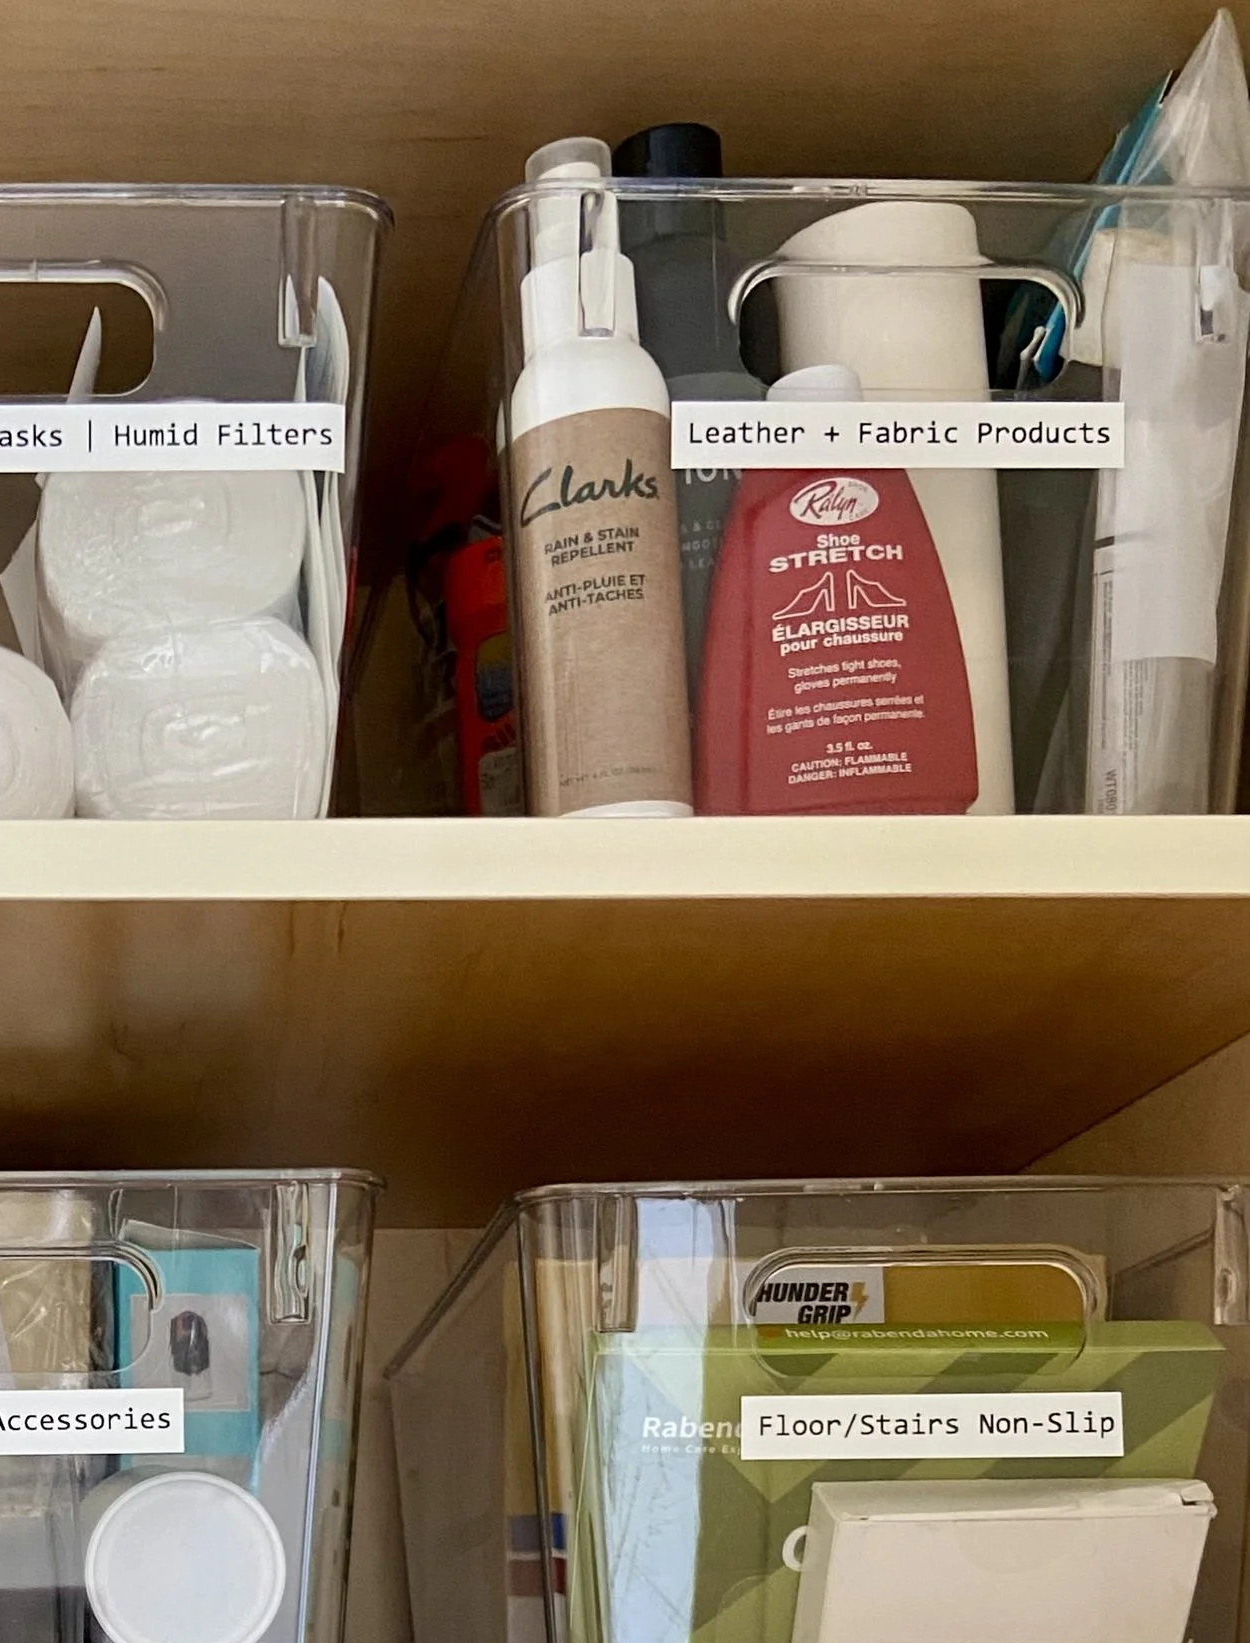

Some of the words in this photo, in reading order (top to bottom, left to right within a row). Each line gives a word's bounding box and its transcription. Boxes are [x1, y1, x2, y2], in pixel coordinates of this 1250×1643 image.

[115, 422, 198, 447] Humid
[218, 422, 333, 447] Filters
[688, 420, 805, 445] Leather
[859, 419, 958, 445] Fabric
[978, 420, 1111, 445] Products
[520, 457, 660, 528] Clarks
[794, 480, 857, 520] Ralyn
[544, 532, 580, 556] RAIN
[583, 531, 594, 544] &
[597, 526, 640, 542] STAIN
[816, 532, 861, 549] Shoe
[550, 540, 635, 568] REPELLENT
[768, 544, 904, 574] STRETCH
[544, 573, 627, 604] ANTI-PLUIE
[629, 573, 646, 586] ET
[548, 588, 645, 617] ANTI-TACHES
[771, 613, 910, 643] ÉLARGISSEUR
[779, 638, 818, 657] pour
[822, 631, 904, 648] chaussure
[787, 664, 840, 679] Stretches
[841, 661, 866, 673] tight
[793, 678, 831, 695] gloves
[832, 671, 898, 690] permanently
[838, 763, 913, 778] INFLAMMABLE
[843, 751, 909, 766] FLAMMABLE
[756, 1281, 850, 1303] HUNDER
[798, 1304, 852, 1325] GRIP
[785, 1326, 1049, 1341] help@rabendahome.com
[642, 1416, 741, 1439] Raben
[759, 1411, 960, 1439] Floor/Stairs
[979, 1409, 1116, 1440] Non-Slip
